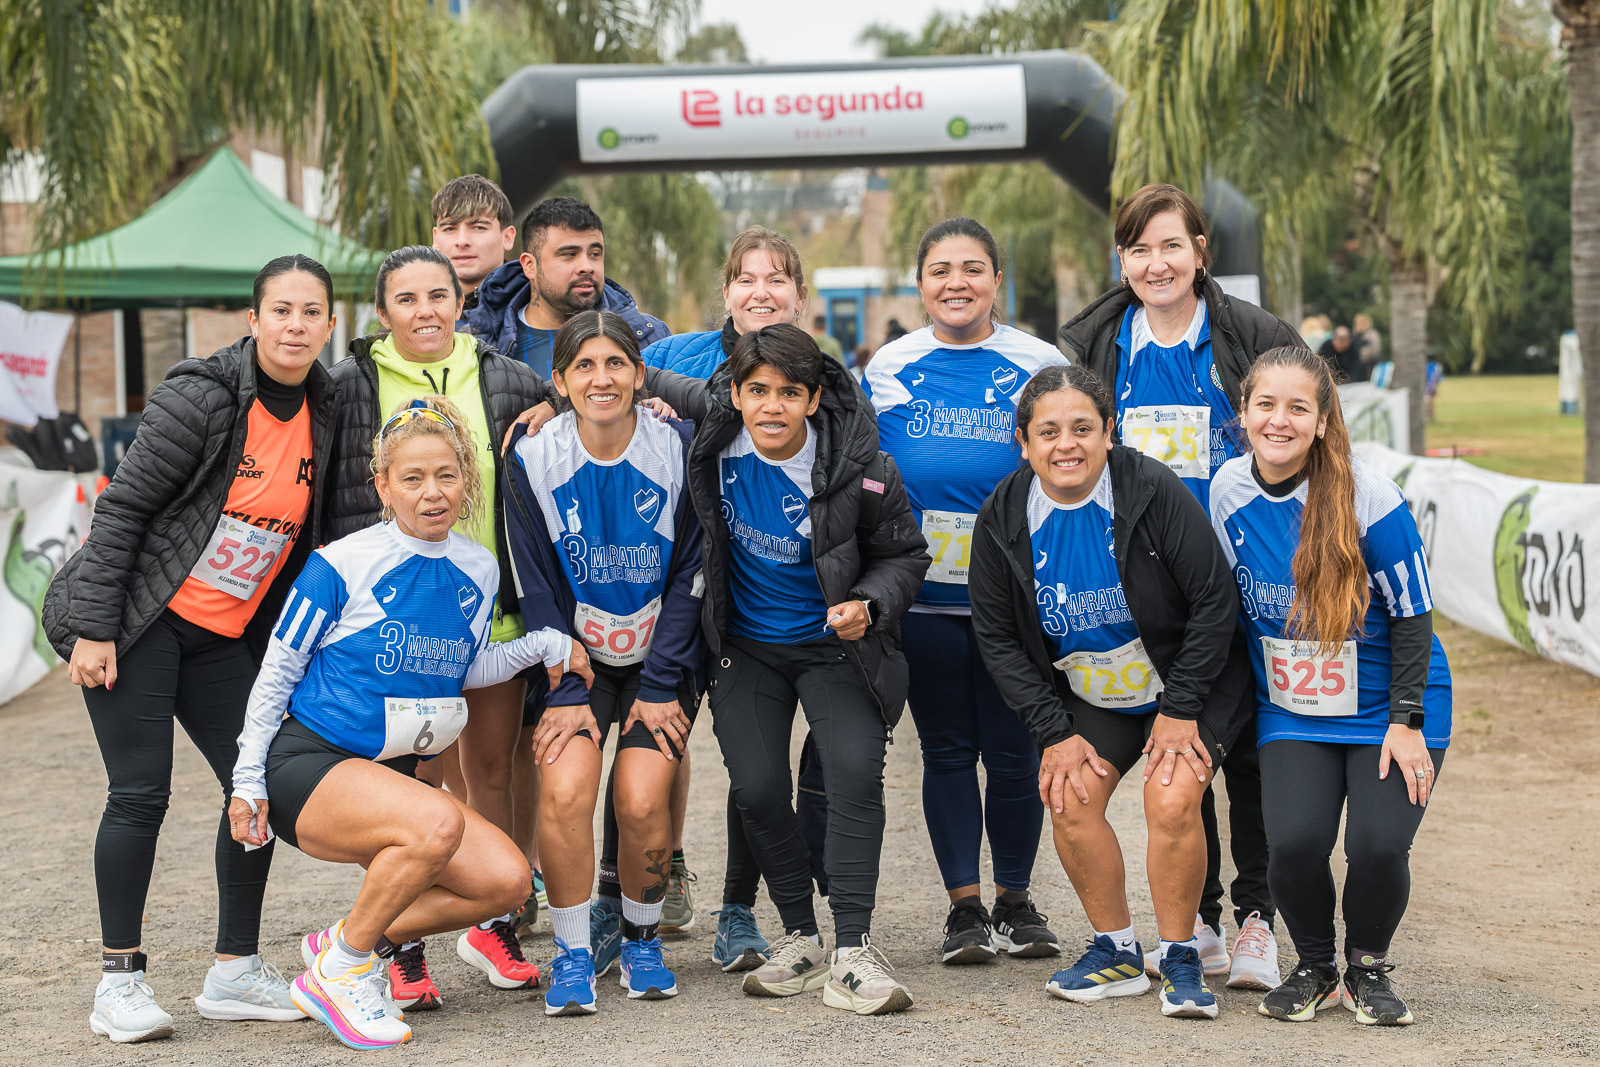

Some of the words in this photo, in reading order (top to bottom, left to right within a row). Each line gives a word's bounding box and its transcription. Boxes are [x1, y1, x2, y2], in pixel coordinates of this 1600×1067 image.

[735, 91, 764, 116] la
[775, 85, 924, 120] segunda
[933, 406, 1013, 430] MARATÓN
[1131, 426, 1198, 461] 735
[734, 518, 800, 556] MARATÓN
[931, 531, 971, 567] 71
[207, 536, 276, 583] 522
[1065, 582, 1128, 616] MARATÓ
[375, 620, 406, 675] 3
[406, 634, 471, 664] MARATÓN
[582, 614, 656, 654] 507
[1073, 661, 1151, 695] 720
[1271, 656, 1346, 697] 525
[413, 720, 434, 753] 6
